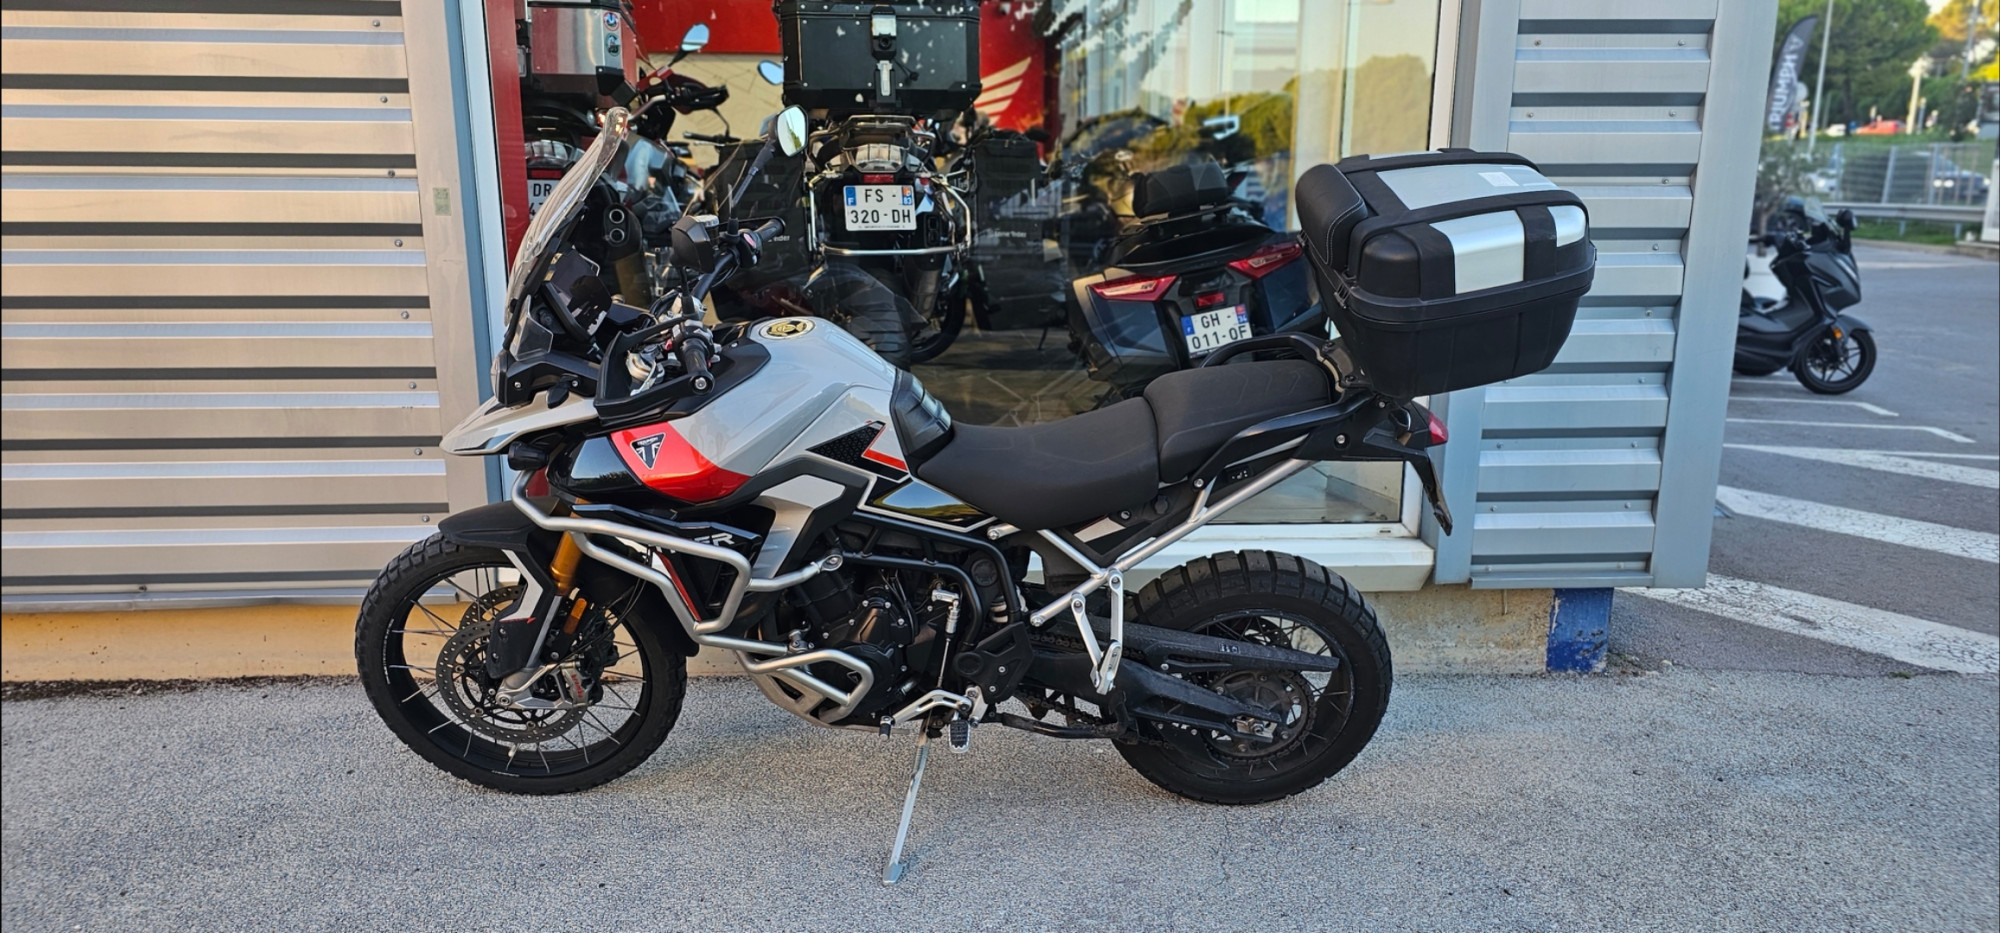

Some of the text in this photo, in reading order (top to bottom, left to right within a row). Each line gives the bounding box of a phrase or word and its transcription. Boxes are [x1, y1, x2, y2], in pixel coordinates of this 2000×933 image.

[1768, 54, 1798, 130] TRIUMPH
[533, 183, 552, 197] DR
[864, 188, 884, 203] FS
[1200, 313, 1220, 329] GH
